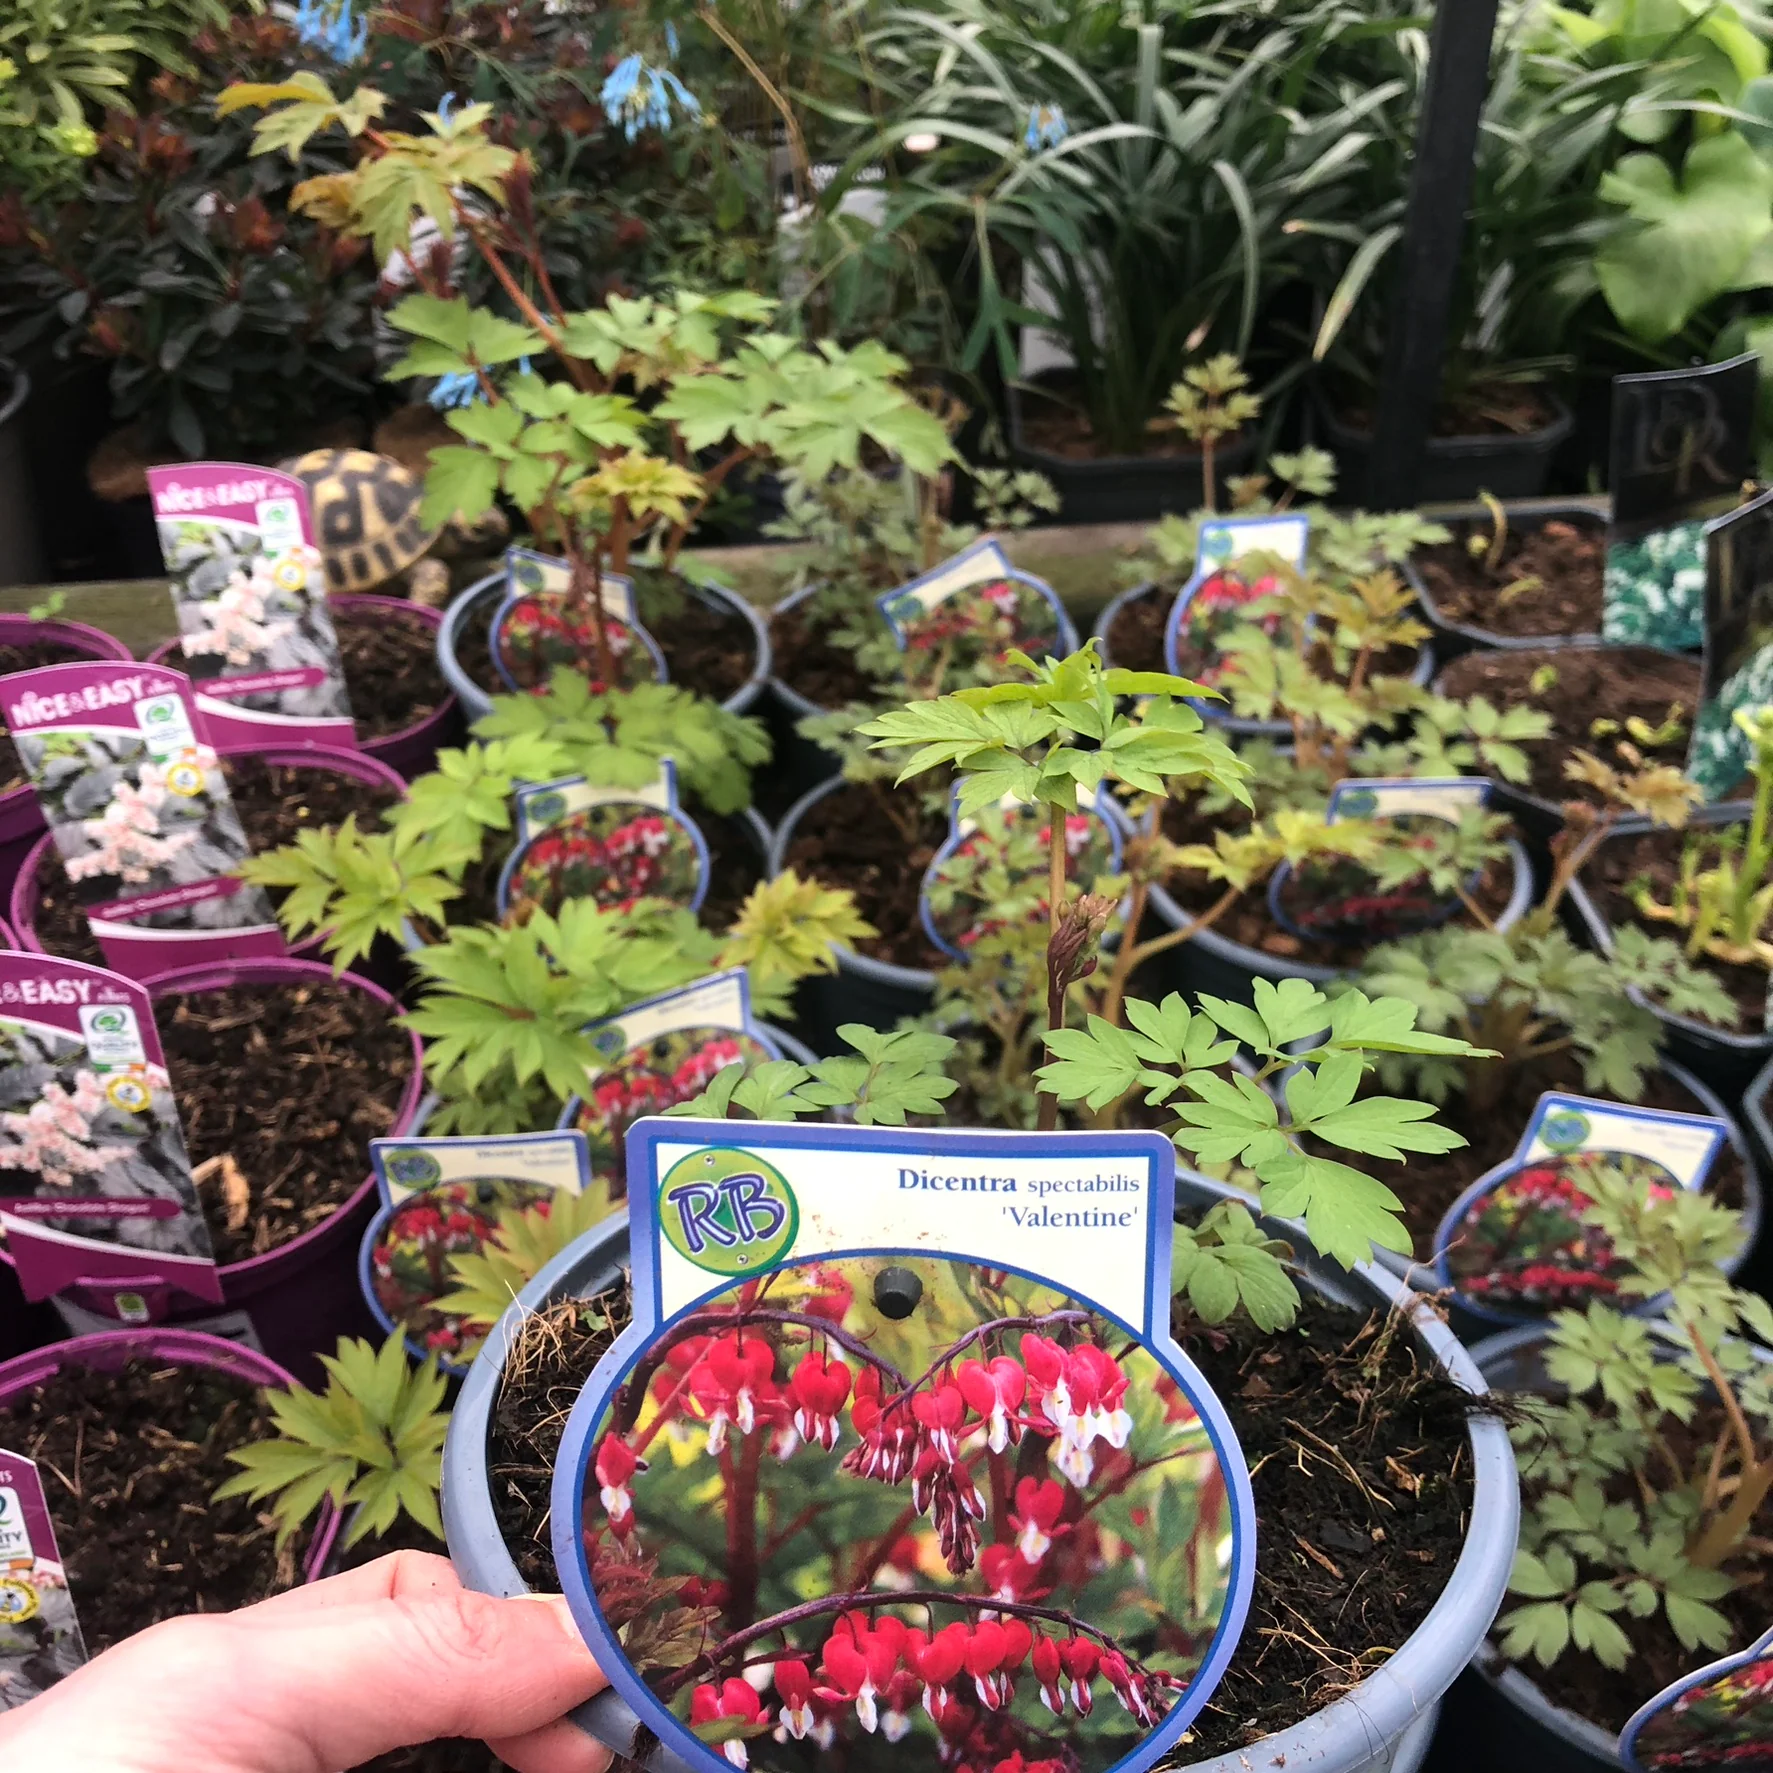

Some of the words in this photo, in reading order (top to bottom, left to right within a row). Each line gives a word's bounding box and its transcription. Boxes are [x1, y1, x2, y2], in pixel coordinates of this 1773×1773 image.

[0, 978, 90, 1005] &EASY
[897, 1168, 1018, 1192] Dicentra
[1027, 1174, 1140, 1198] spectabilis
[667, 1171, 787, 1254] RB
[1002, 1205, 1138, 1228] 'Valentine'
